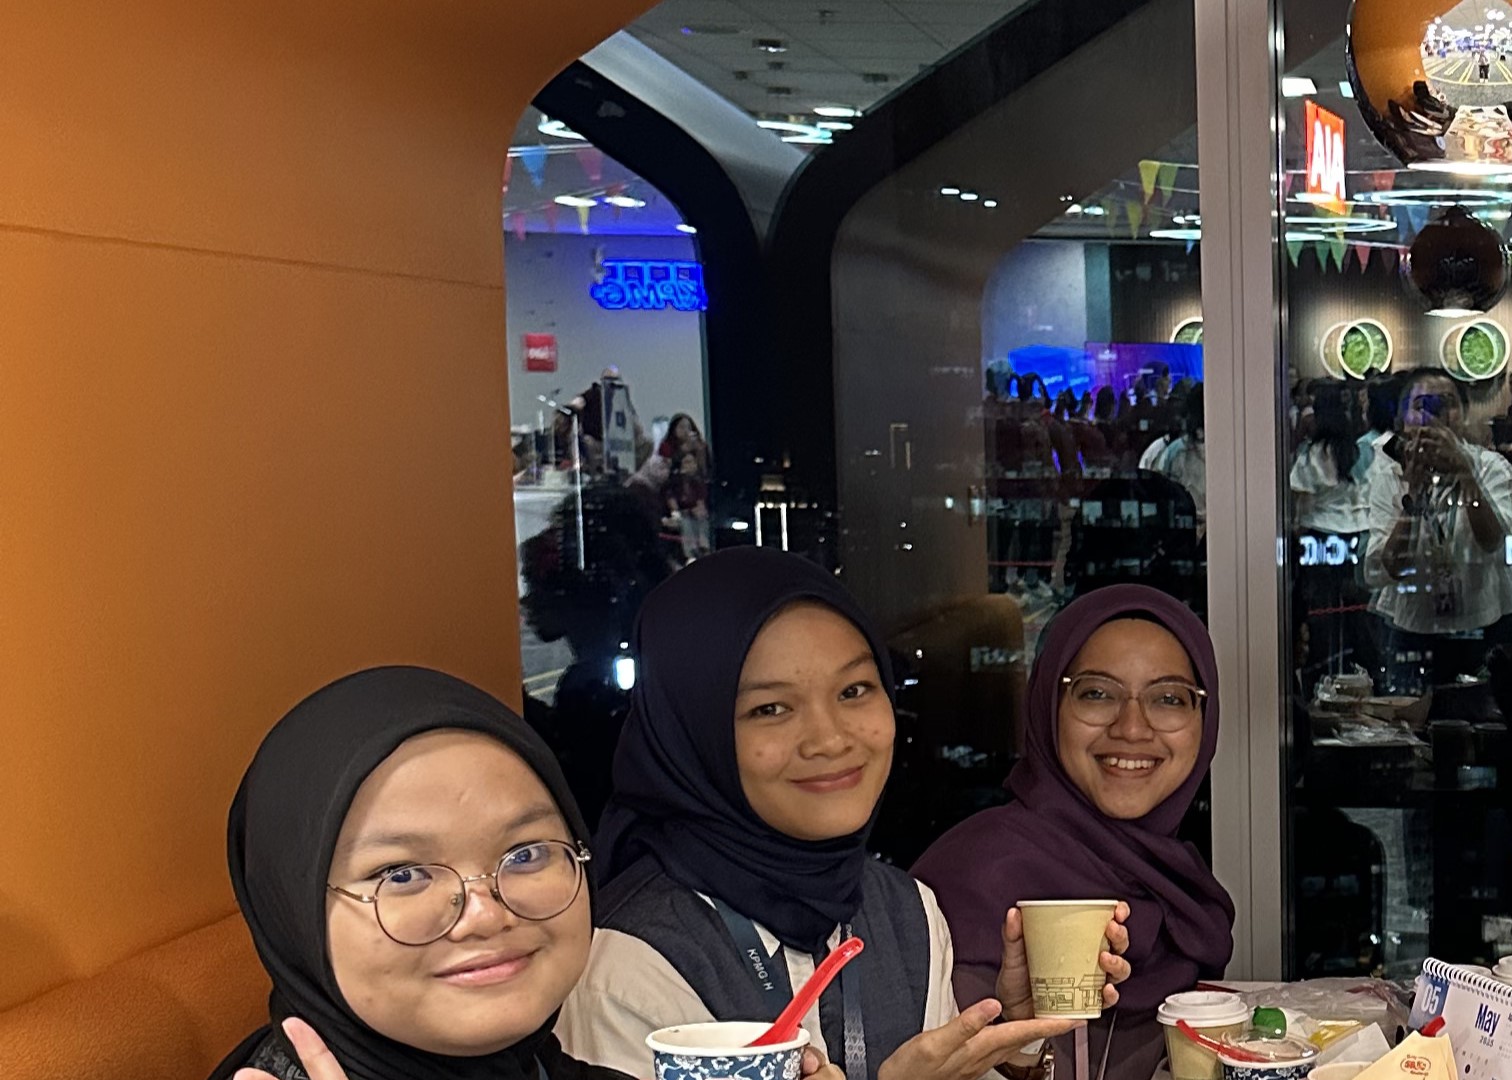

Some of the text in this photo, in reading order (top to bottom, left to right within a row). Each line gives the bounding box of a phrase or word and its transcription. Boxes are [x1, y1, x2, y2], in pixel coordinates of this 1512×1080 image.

[1310, 119, 1346, 201] AIA
[1421, 983, 1442, 1015] 05
[1475, 1003, 1501, 1038] May
